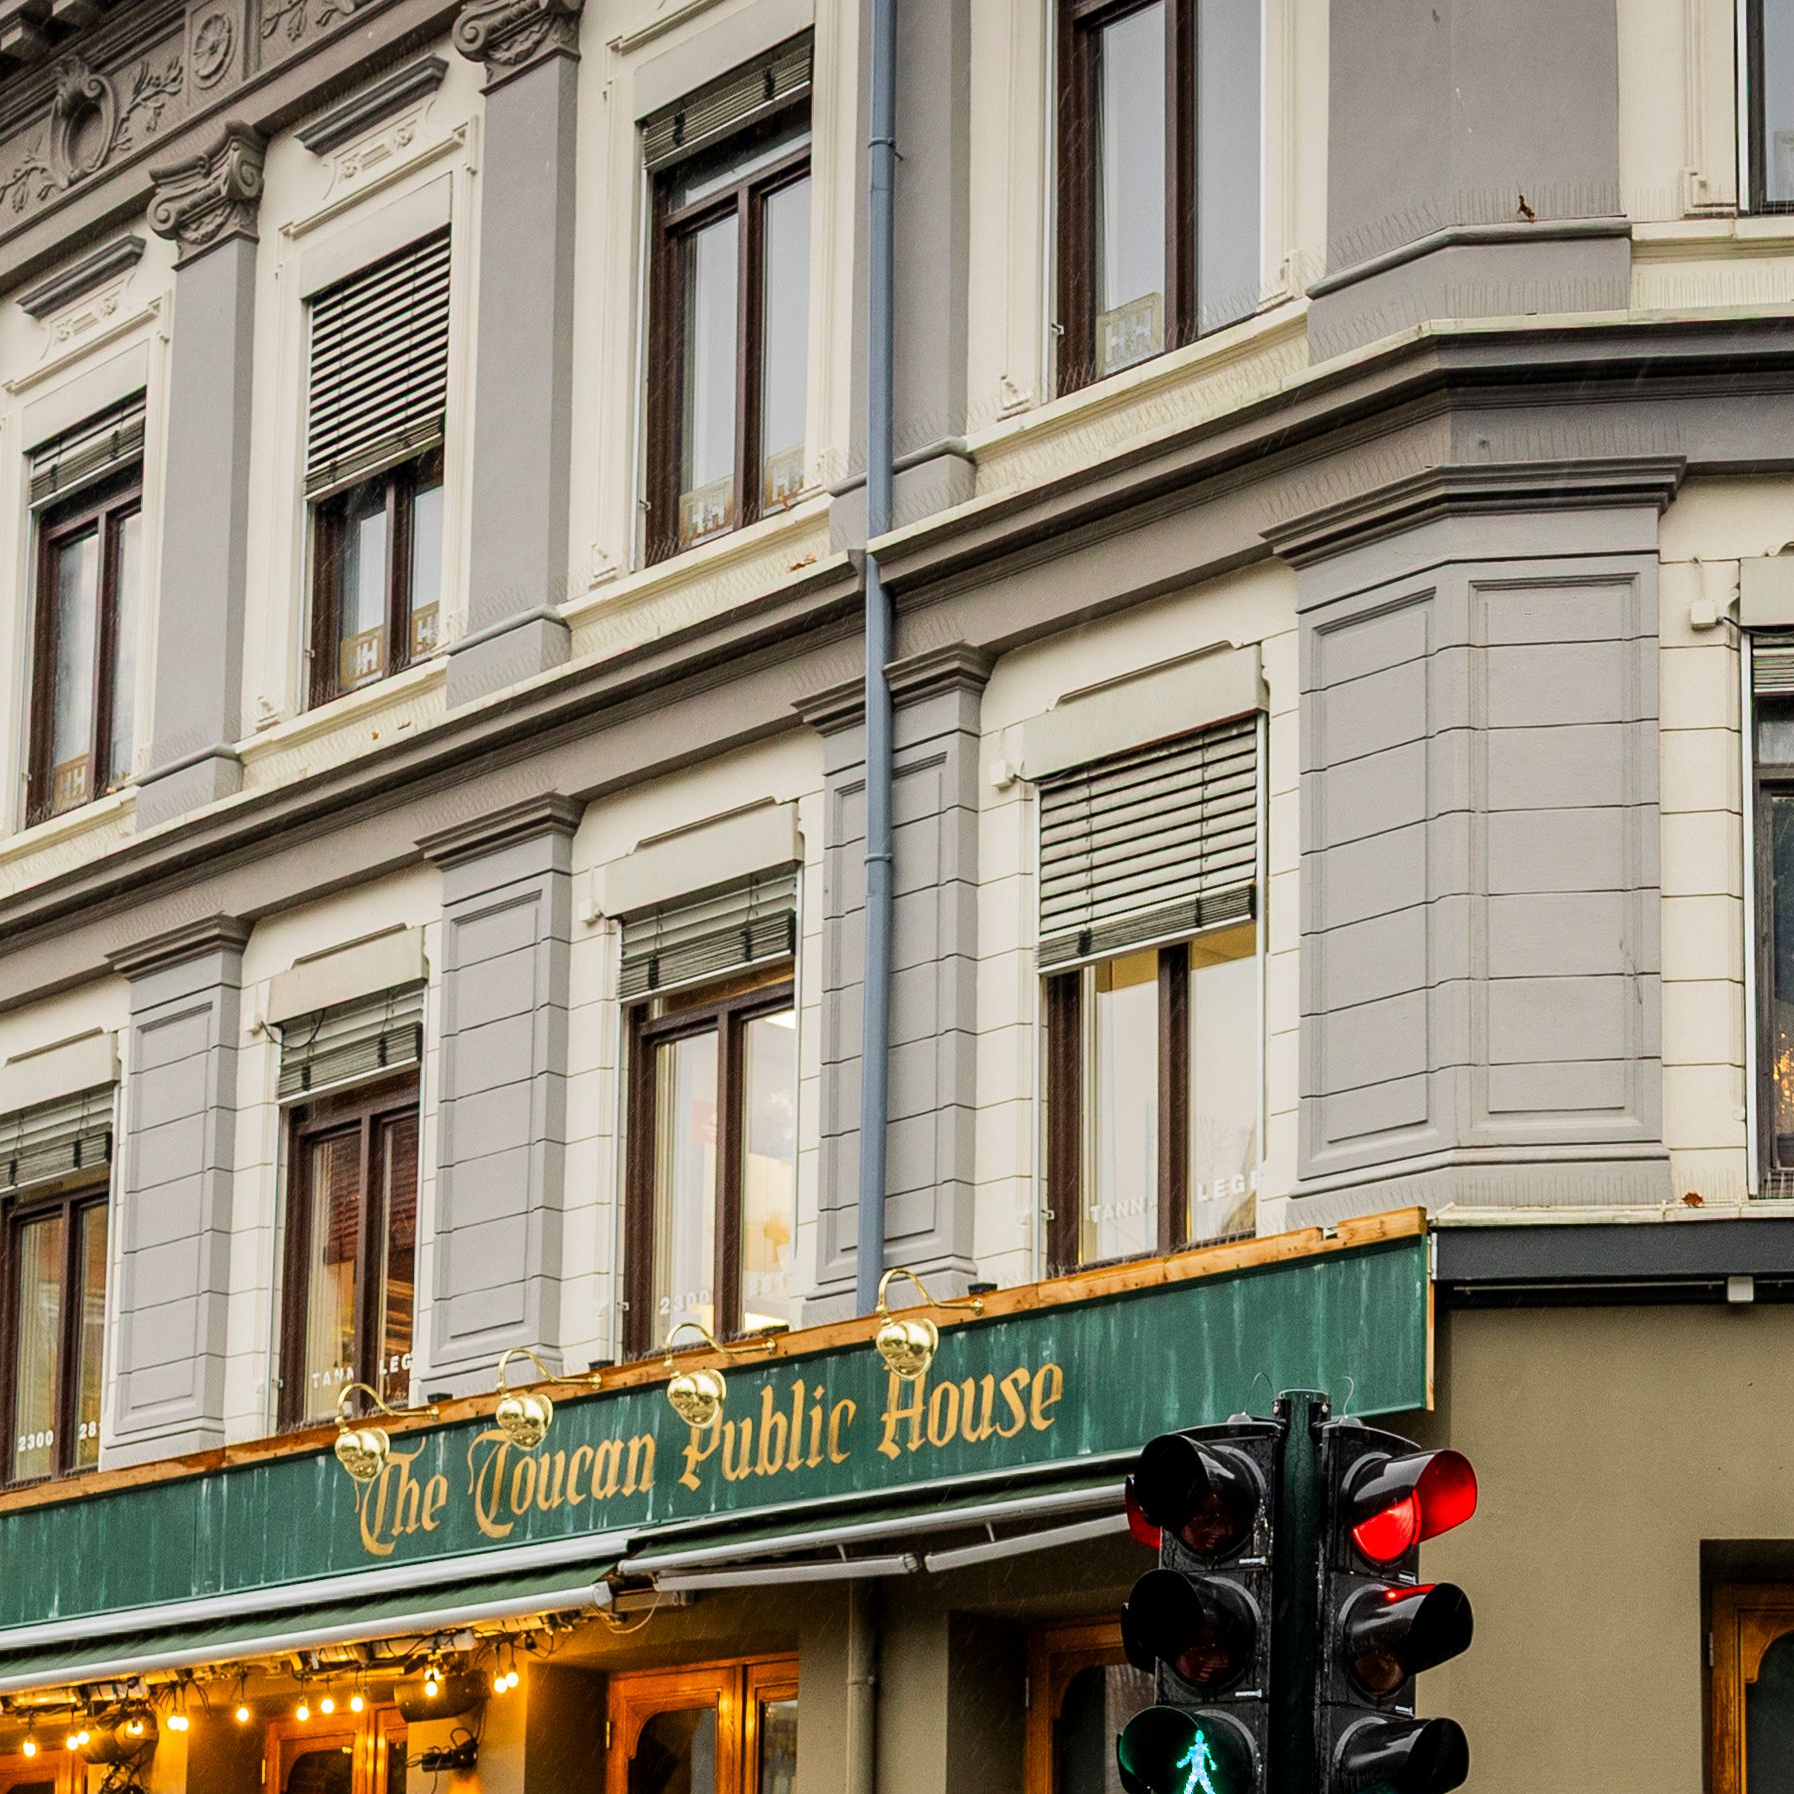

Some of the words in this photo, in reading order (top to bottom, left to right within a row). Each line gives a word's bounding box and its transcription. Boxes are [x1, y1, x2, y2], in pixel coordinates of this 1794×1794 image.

[17, 1430, 54, 1452] 2300
[79, 1421, 101, 1440] 28
[353, 1438, 449, 1556] The
[467, 1429, 658, 1540] Toucan
[679, 1378, 857, 1492] Public
[877, 1361, 1064, 1461] House
